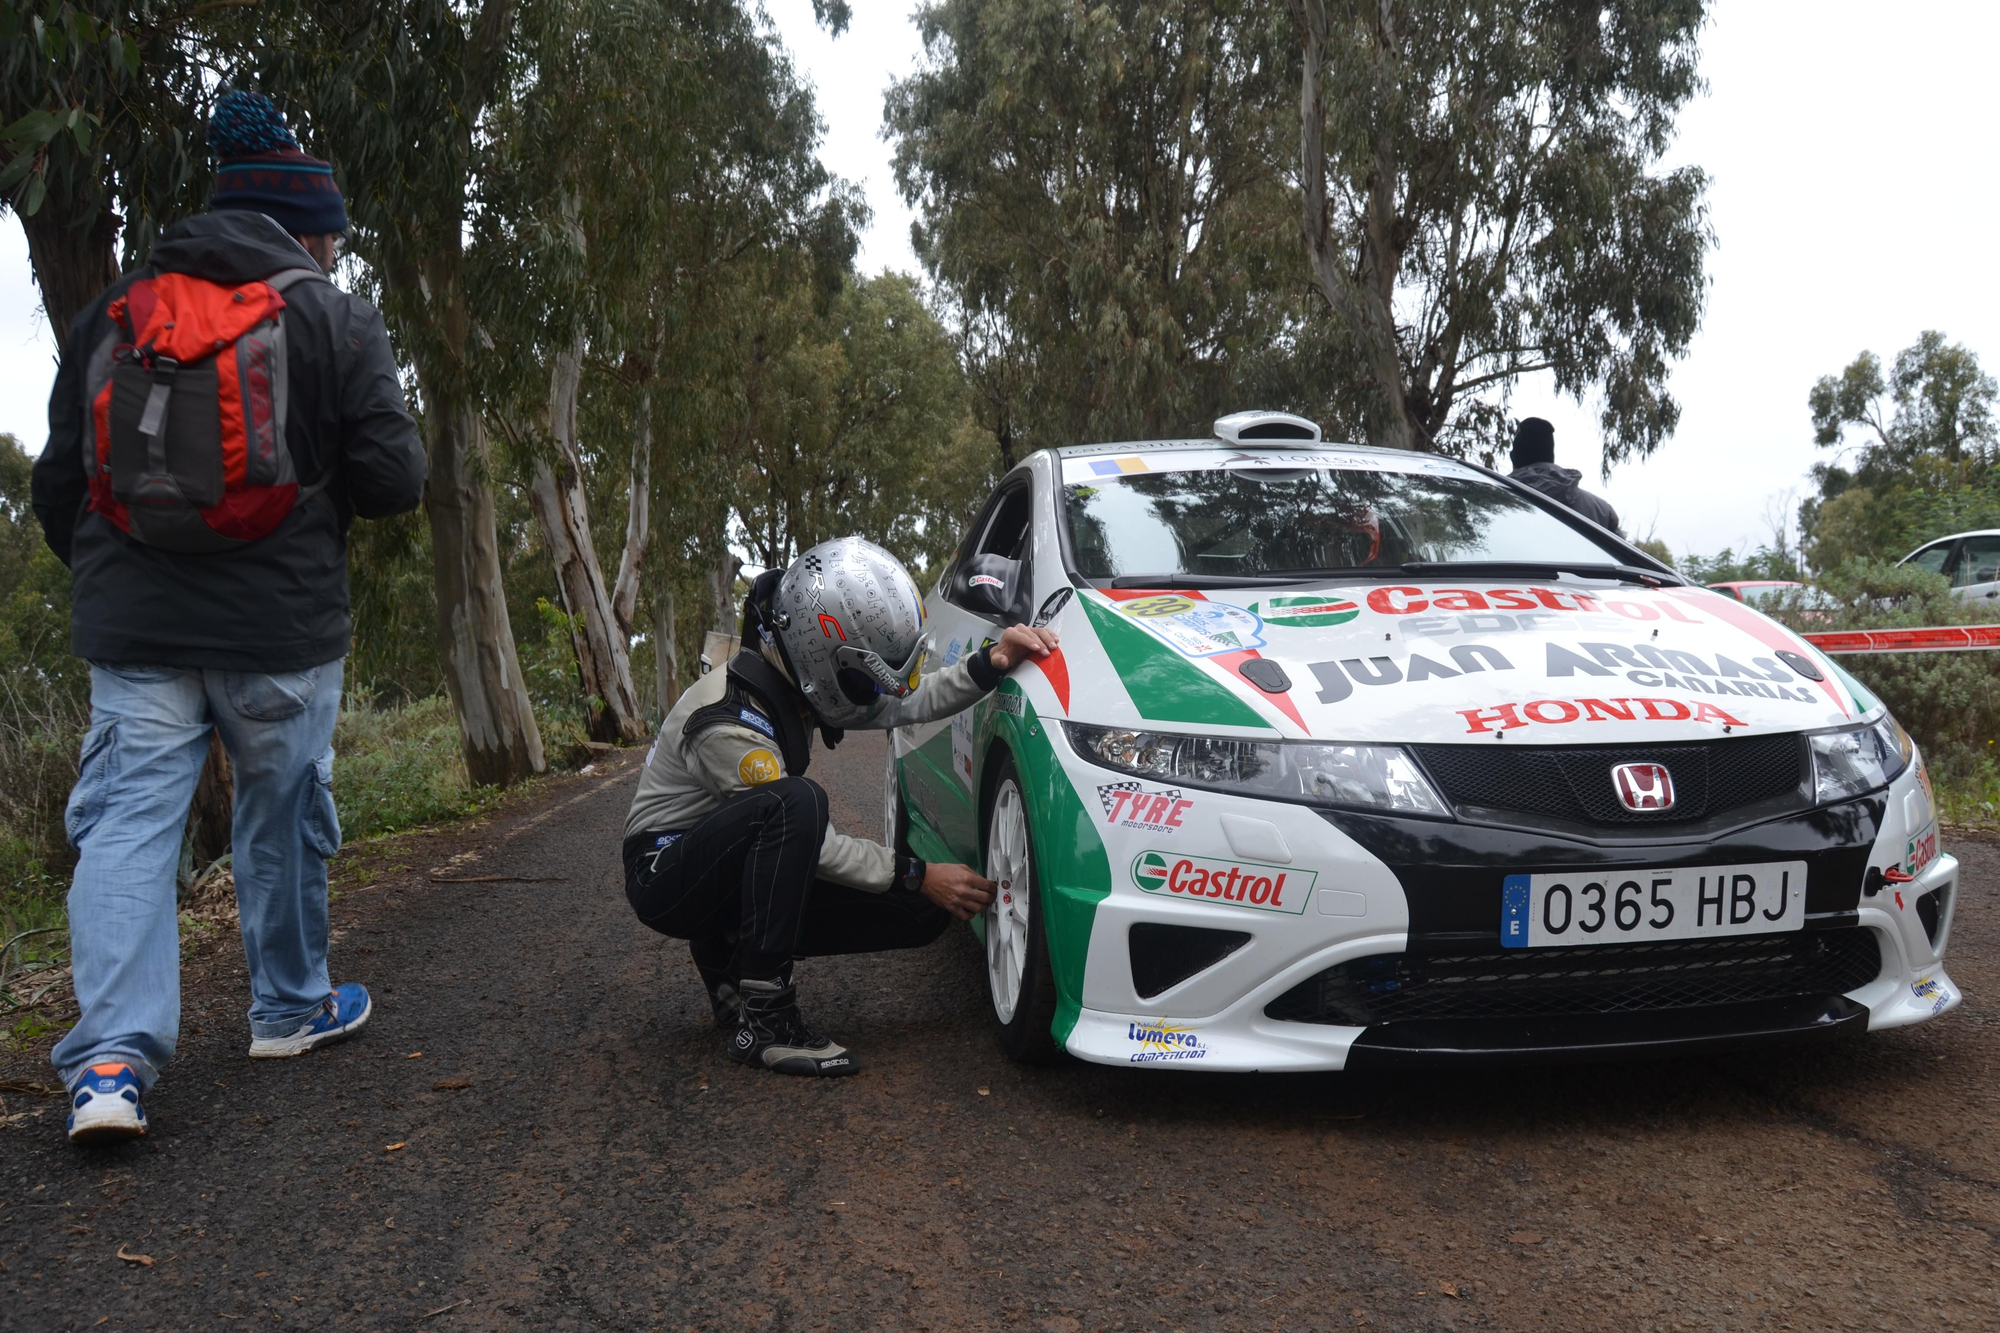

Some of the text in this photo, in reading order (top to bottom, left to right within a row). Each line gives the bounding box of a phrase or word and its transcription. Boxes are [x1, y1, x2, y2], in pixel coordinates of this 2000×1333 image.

[1276, 453, 1380, 467] LOPESAN
[974, 575, 999, 586] Castrol
[1125, 597, 1191, 617] 39
[1366, 586, 1704, 624] Castrol
[1398, 612, 1636, 638] EDGE
[1307, 641, 1794, 704] JUAN ARMAS
[1626, 670, 1818, 704] CANARIAS
[1455, 697, 1749, 735] HONDA
[1107, 790, 1194, 827] TYRE
[1121, 820, 1174, 834] motorsport
[1914, 825, 1938, 872] Castrol
[1168, 859, 1287, 907] Castrol
[1543, 870, 1789, 935] 0365 HBJ
[1510, 920, 1520, 935] E
[820, 1057, 849, 1069] sparco
